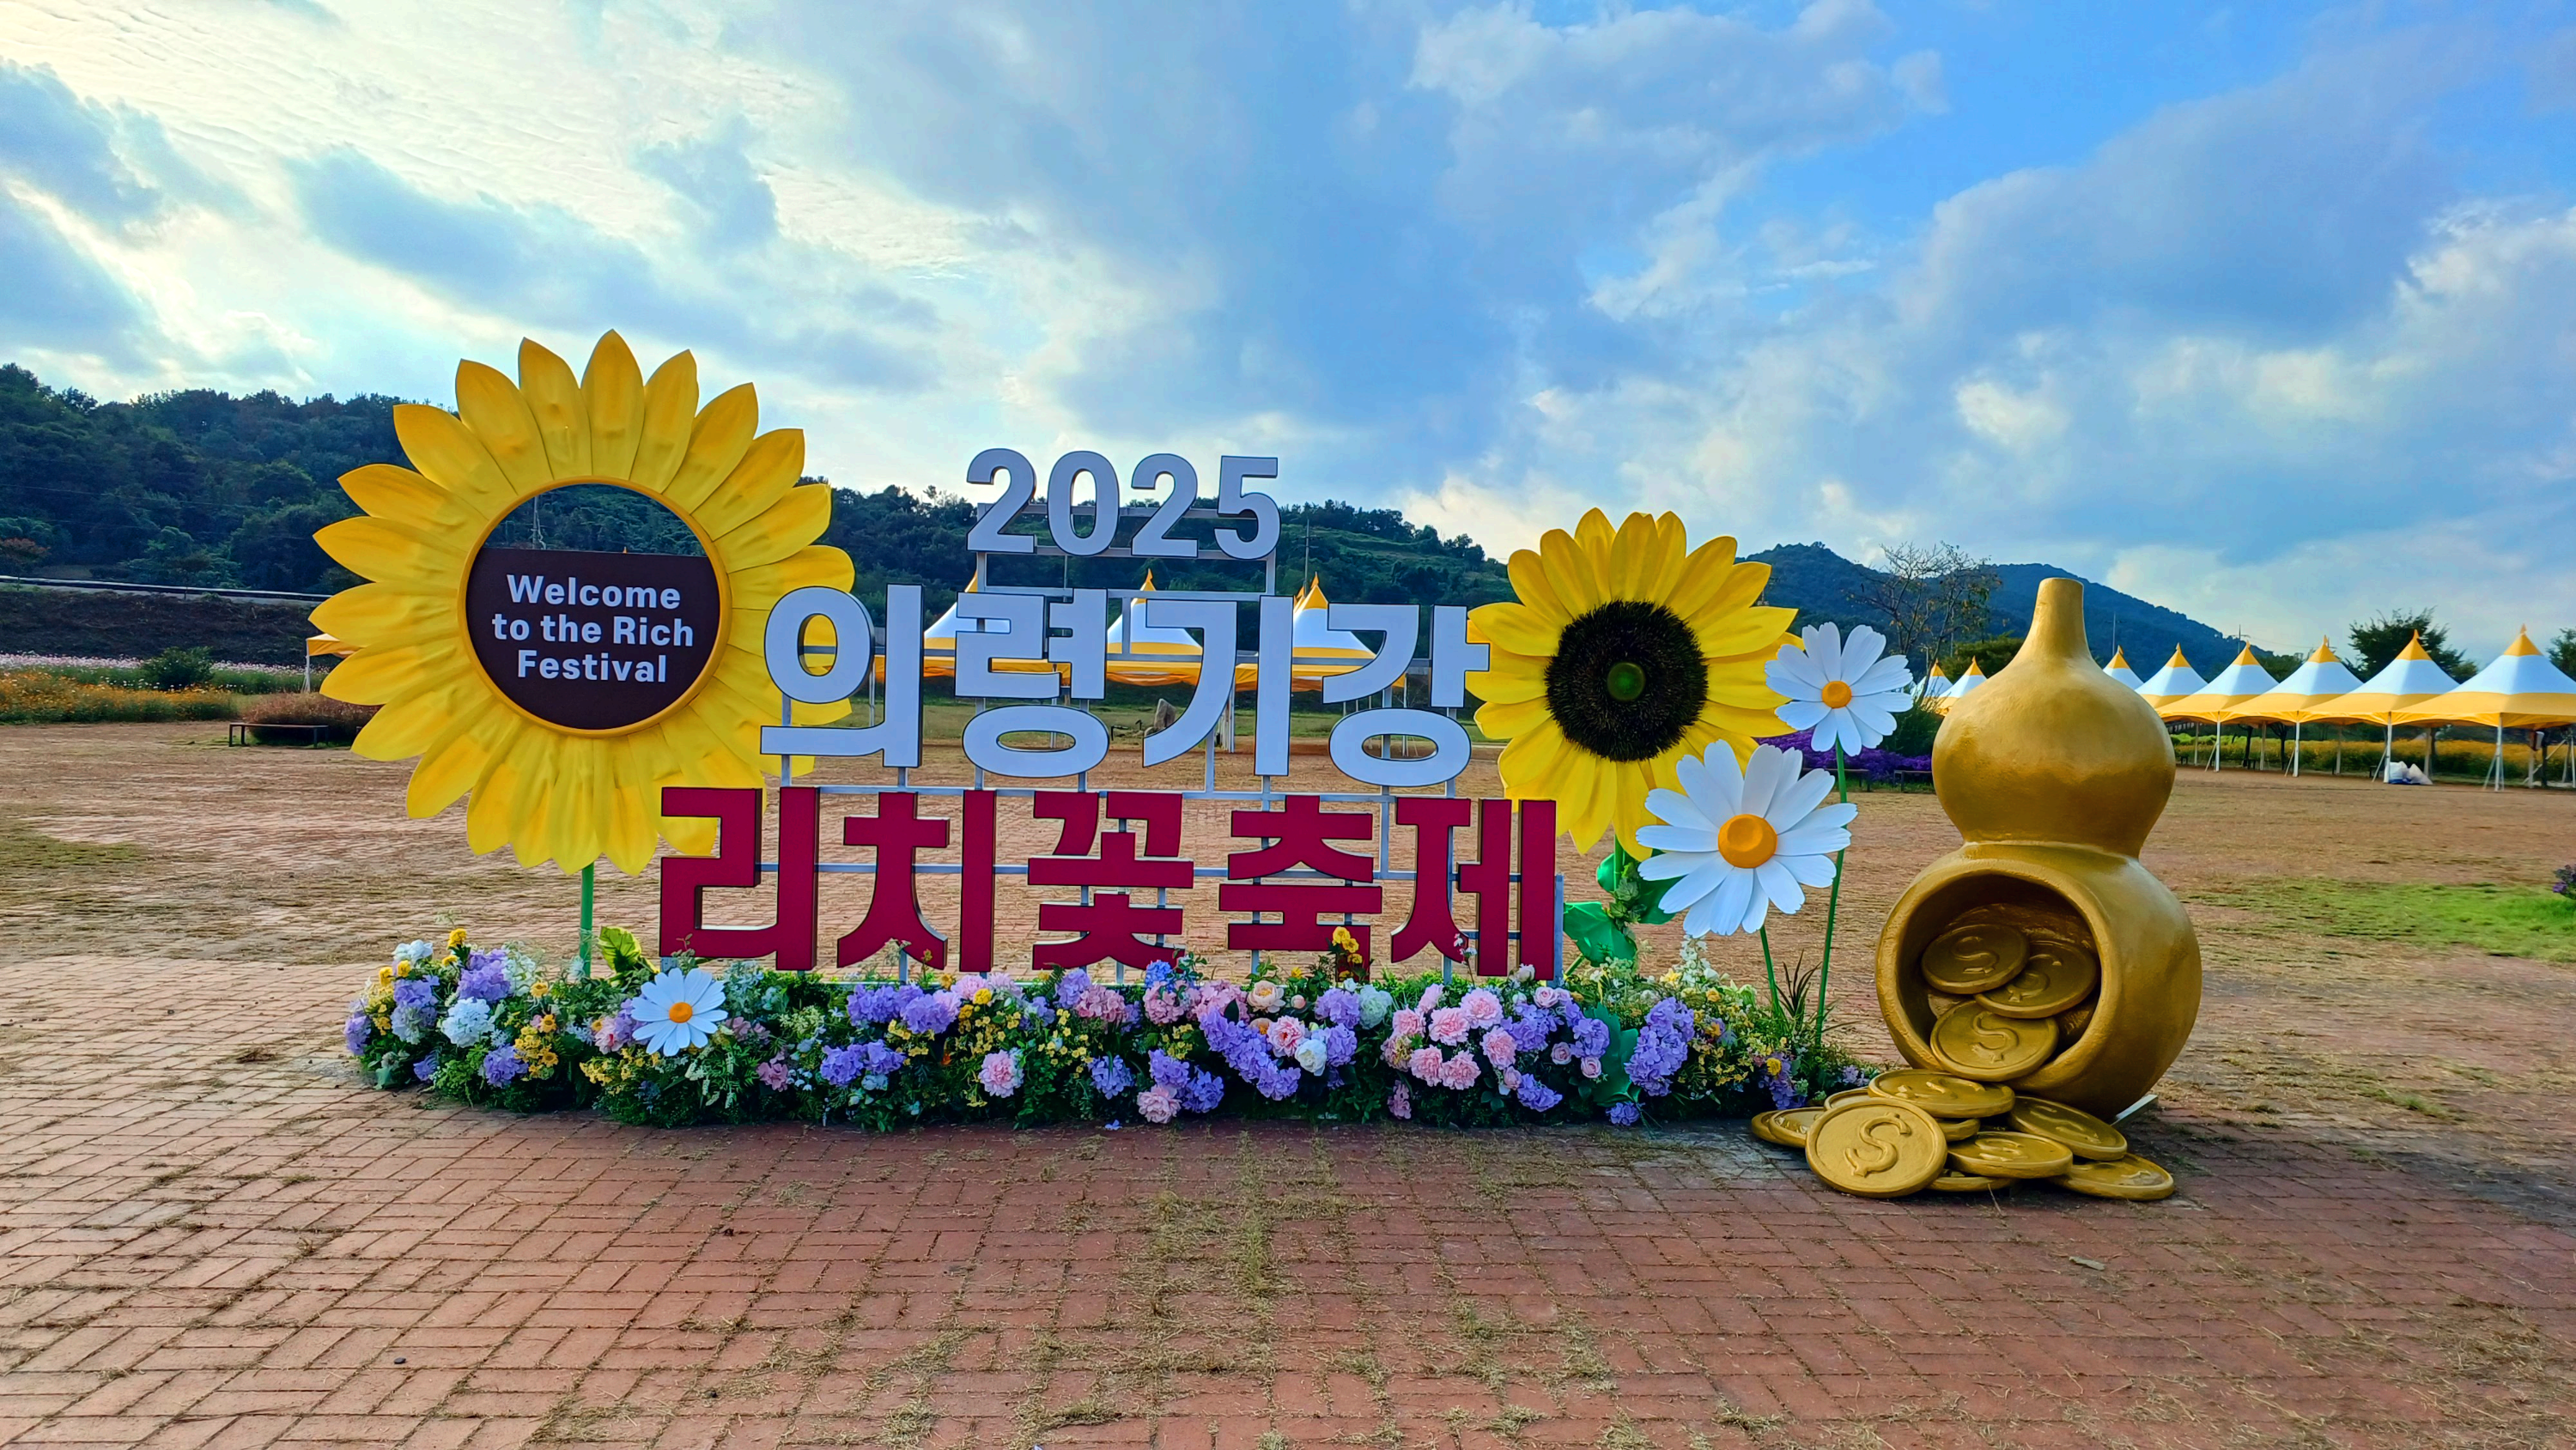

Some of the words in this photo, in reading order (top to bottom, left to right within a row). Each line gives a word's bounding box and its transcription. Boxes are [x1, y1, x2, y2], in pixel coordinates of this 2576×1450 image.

[966, 448, 1280, 561] 2025
[507, 574, 681, 609] Welcome
[492, 614, 530, 641] to
[541, 615, 602, 644] the
[614, 616, 694, 646] Rich
[518, 650, 667, 683] Festival
[761, 584, 1490, 787] 의령기강
[659, 786, 1556, 981] 리치꽃축제
